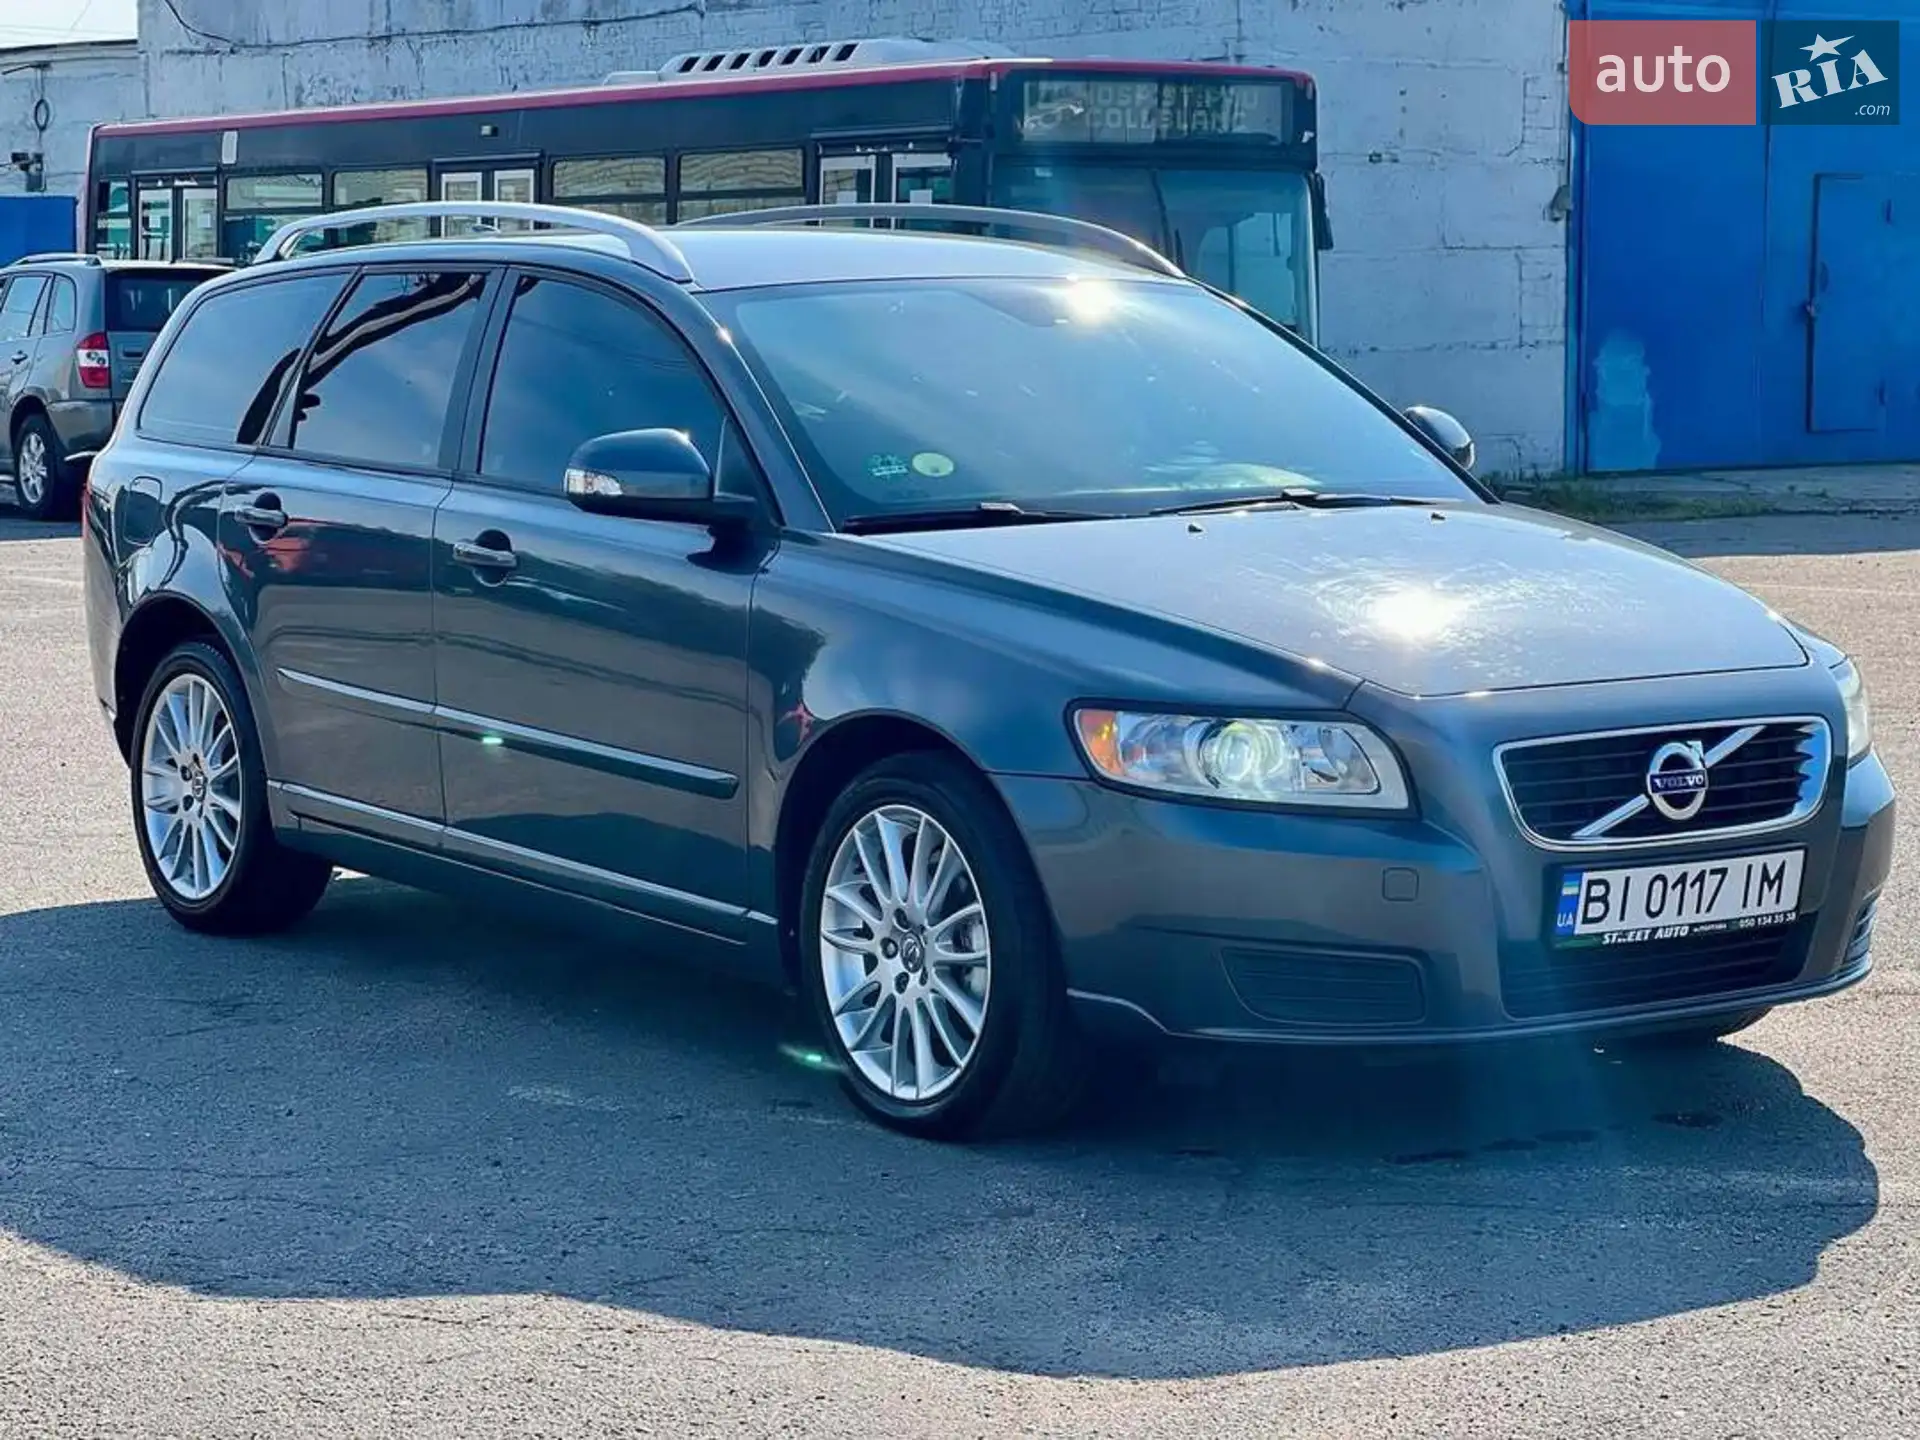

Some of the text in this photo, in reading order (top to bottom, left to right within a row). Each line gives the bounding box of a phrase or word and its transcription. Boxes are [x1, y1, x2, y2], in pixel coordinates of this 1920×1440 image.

[1653, 774, 1704, 789] VOLVO
[1581, 860, 1786, 925] BI 0117 IM
[1556, 912, 1574, 928] UA
[1655, 925, 1690, 939] AUTO
